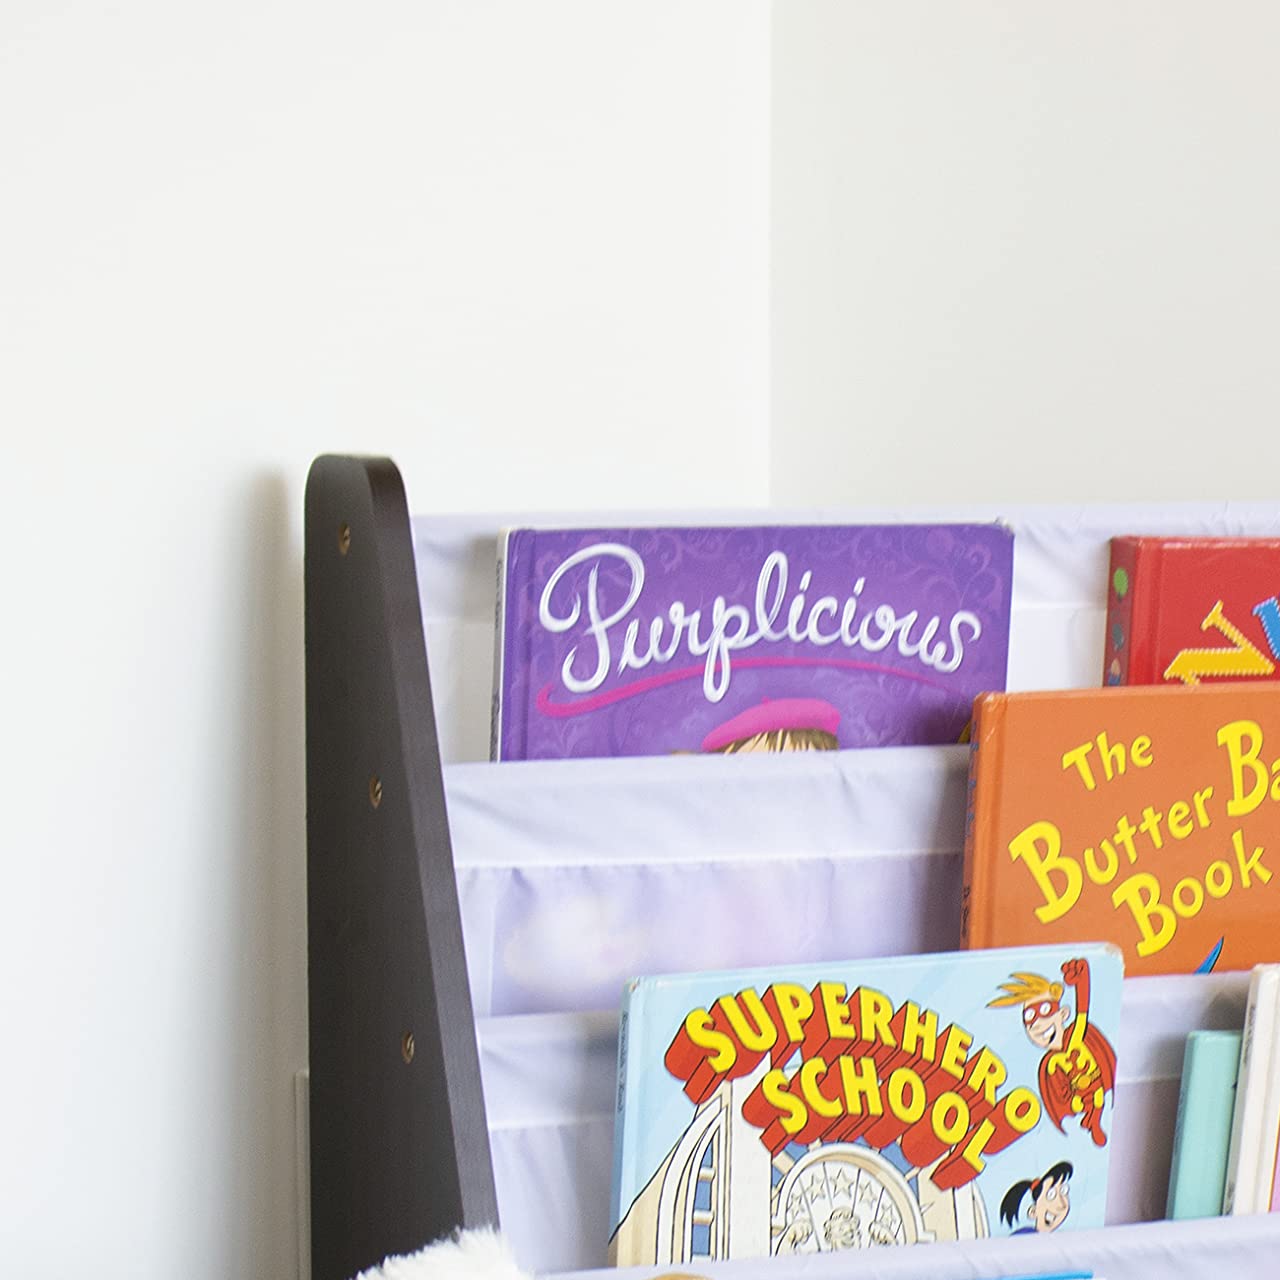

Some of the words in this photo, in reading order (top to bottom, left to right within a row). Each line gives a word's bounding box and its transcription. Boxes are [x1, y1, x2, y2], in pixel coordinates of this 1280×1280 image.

[539, 543, 981, 702] Purplicious
[1062, 731, 1154, 791] The
[1008, 784, 1215, 924] Butter
[1112, 829, 1274, 957] Book
[686, 981, 1041, 1133] SUPERHERO
[762, 1055, 998, 1174] SCHOOL
